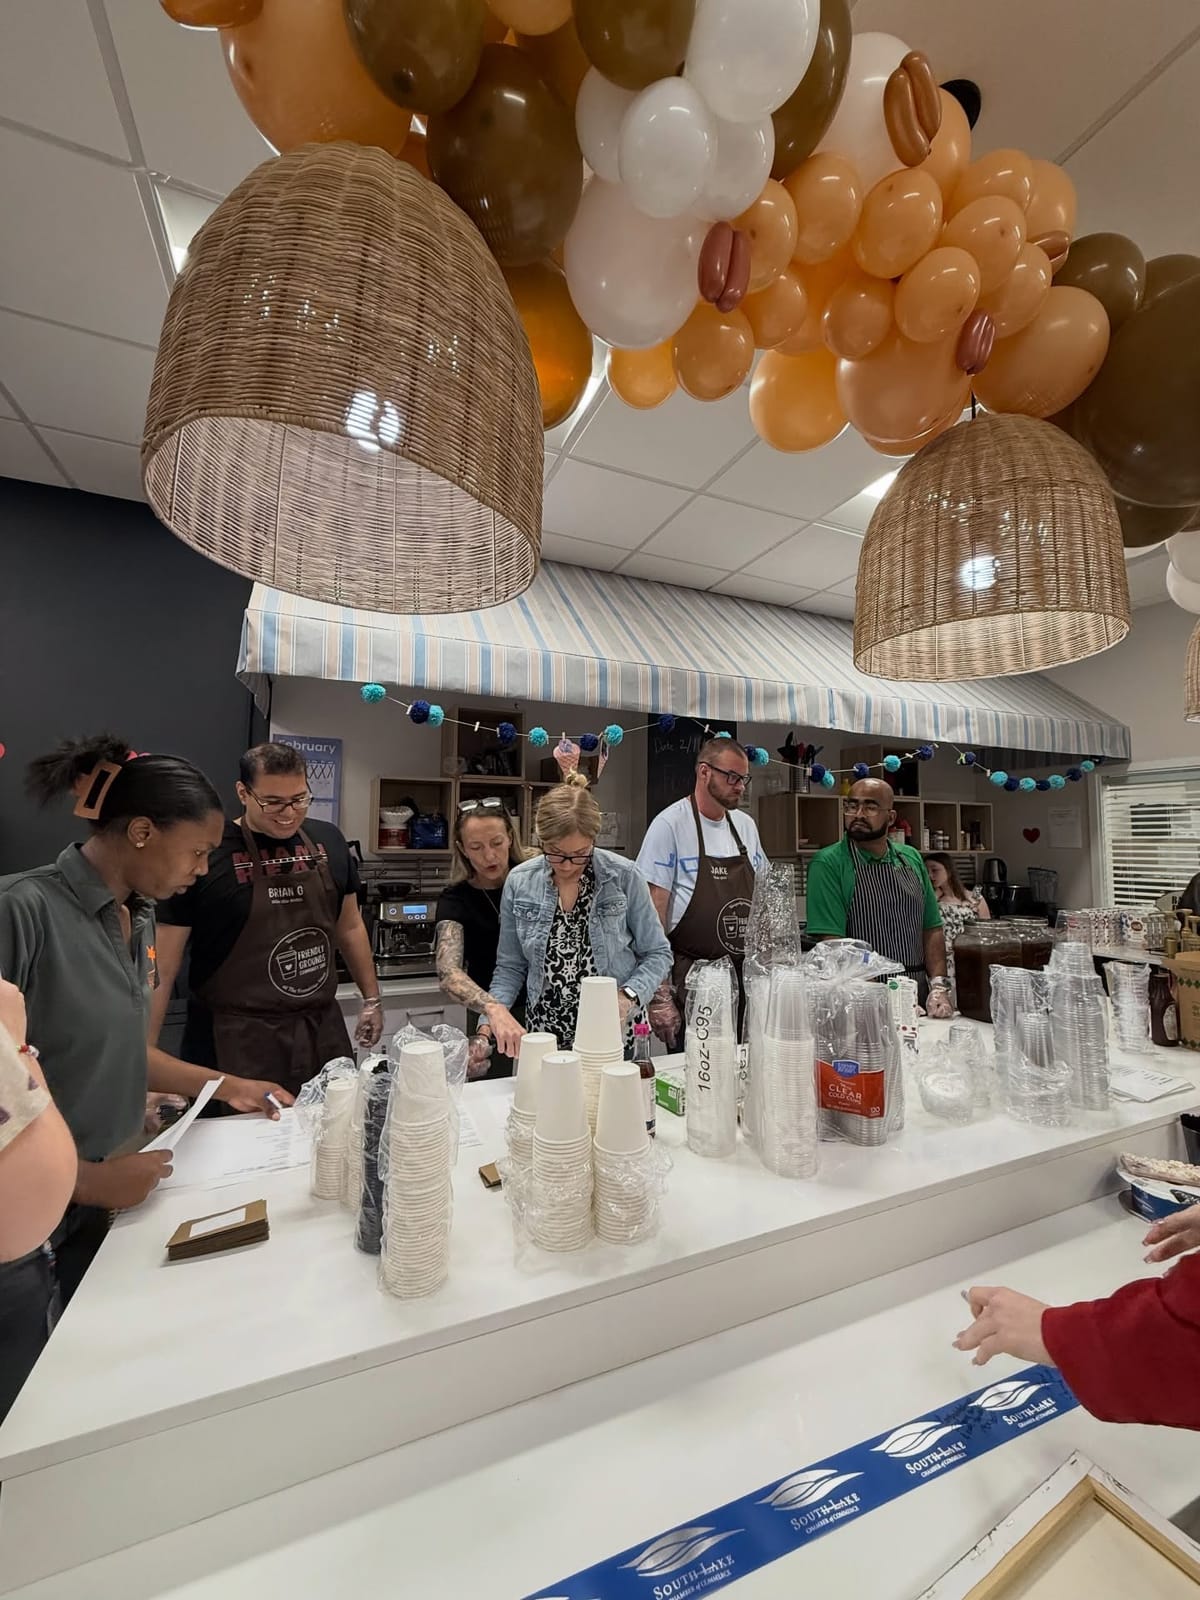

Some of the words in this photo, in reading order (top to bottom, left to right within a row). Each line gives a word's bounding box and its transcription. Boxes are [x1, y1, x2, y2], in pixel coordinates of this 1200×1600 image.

[710, 866, 729, 875] JAKE
[268, 887, 295, 898] BRIAN
[297, 944, 325, 961] FRIENDLY
[298, 953, 326, 970] GROUNDS
[695, 1004, 713, 1092] 16oz-C95
[828, 1083, 862, 1100] CLEAR
[828, 1091, 846, 1099] COLD
[1002, 1408, 1034, 1425] SOUTH
[1029, 1397, 1056, 1413] LAKE
[905, 1450, 940, 1474] SOUTH
[937, 1441, 966, 1457] LAKE
[790, 1505, 830, 1530] SOUTH
[828, 1493, 860, 1510] LAKE
[653, 1569, 699, 1600] SOUTH
[700, 1554, 735, 1576] LAKE
